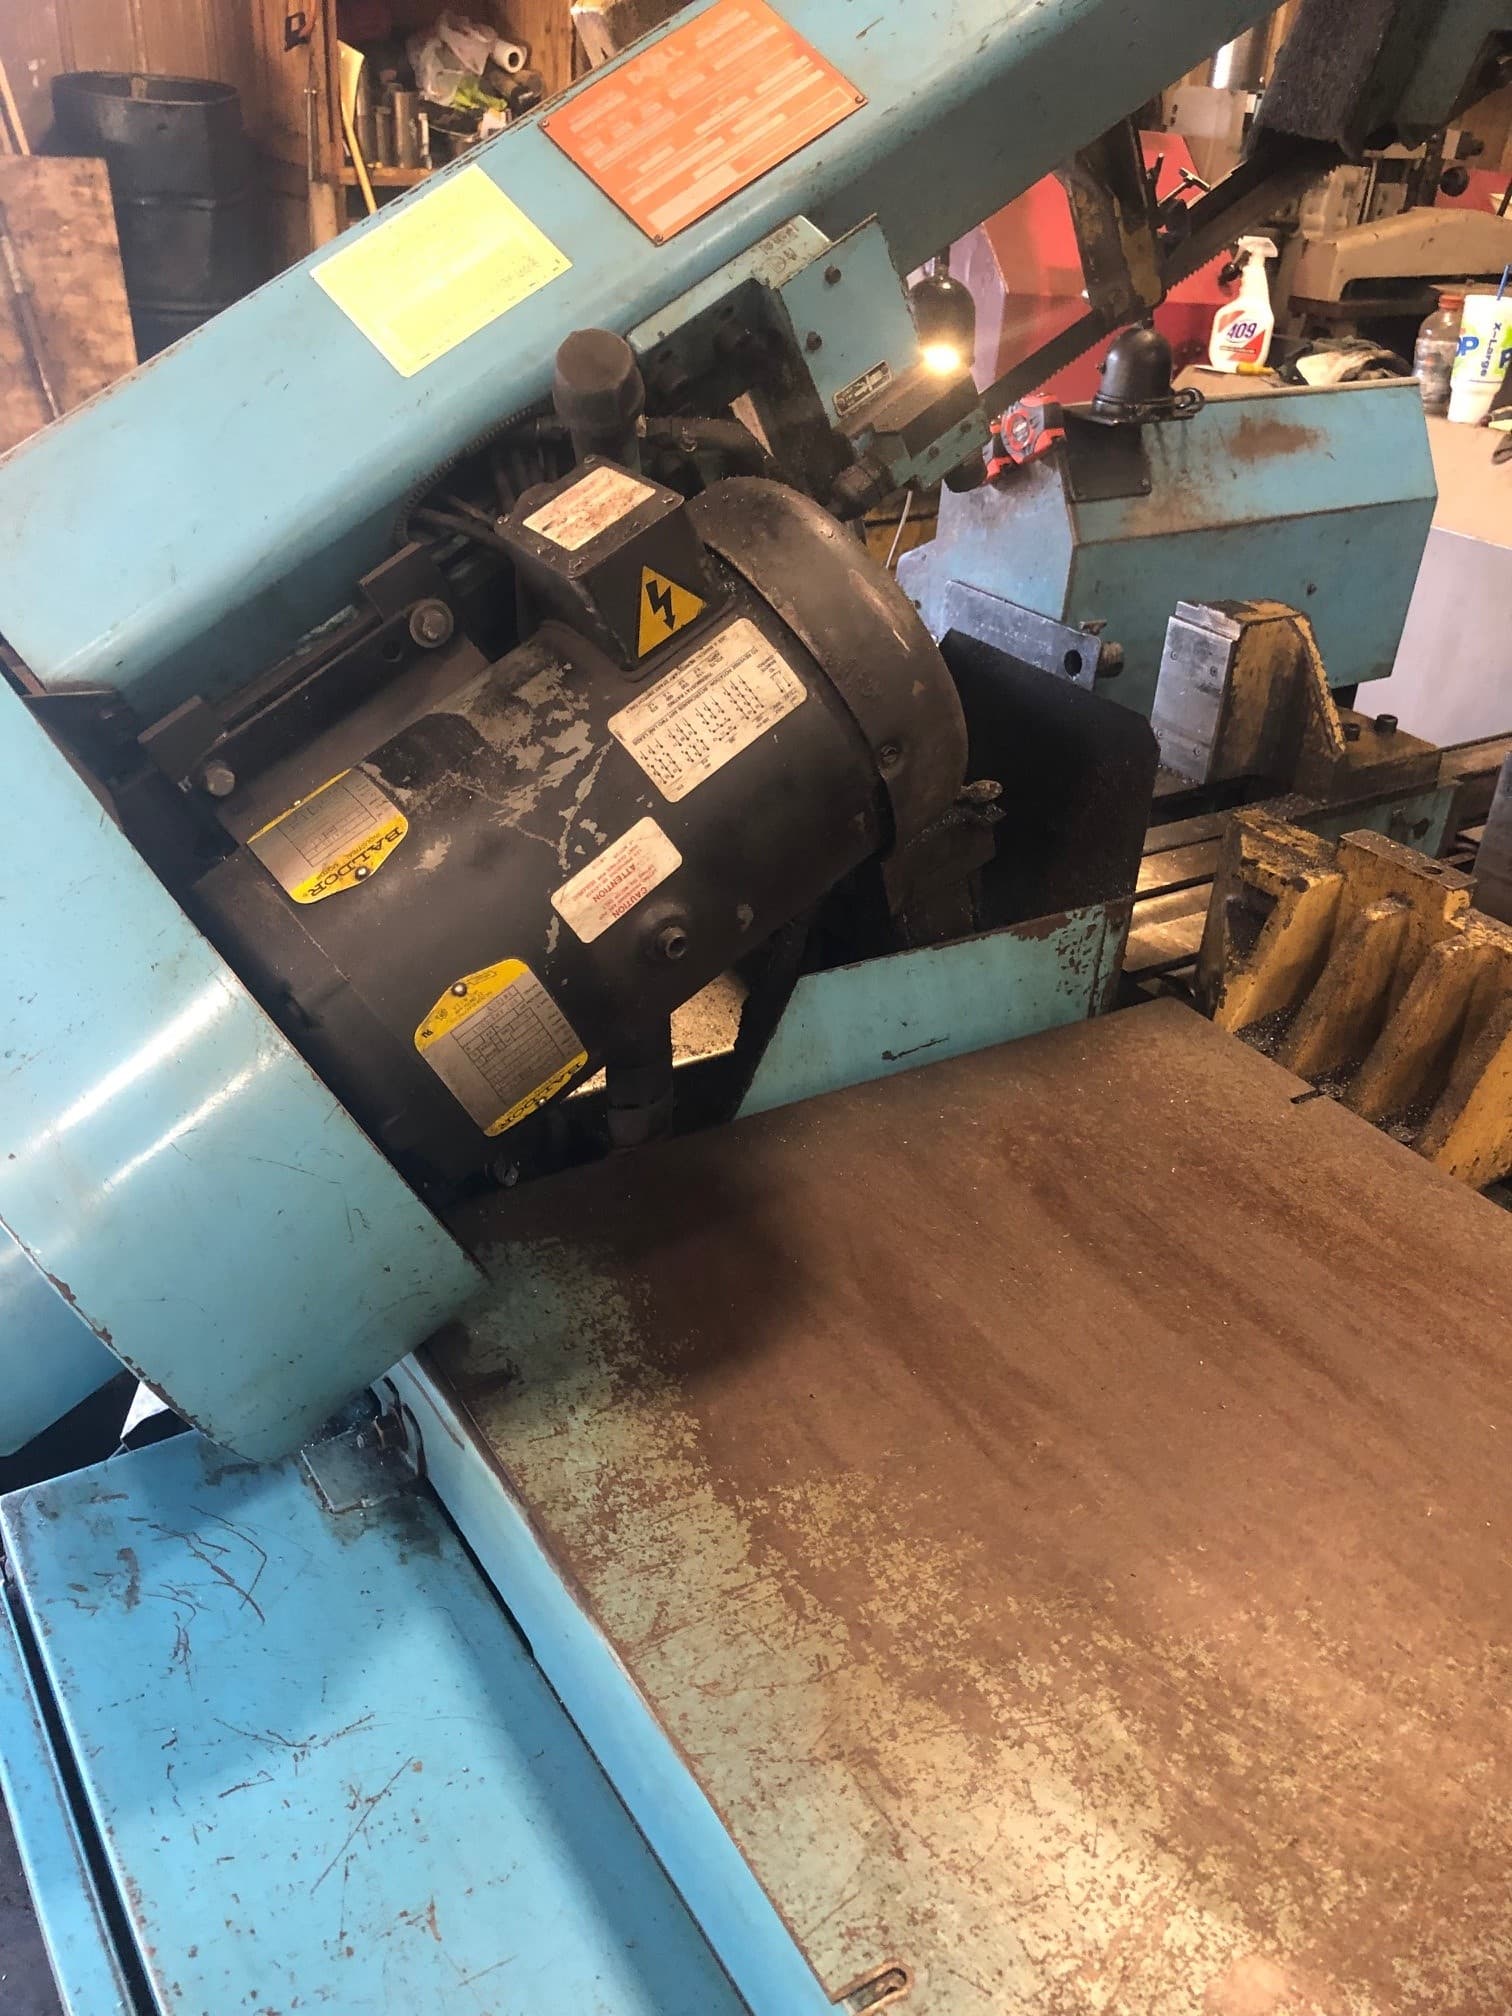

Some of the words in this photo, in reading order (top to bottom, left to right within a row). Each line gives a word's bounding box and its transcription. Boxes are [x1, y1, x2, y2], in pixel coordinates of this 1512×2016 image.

[1226, 322, 1257, 339] 409
[308, 827, 403, 897] BALDOR
[592, 863, 637, 903] ATTENTION
[612, 886, 648, 918] CAUTION
